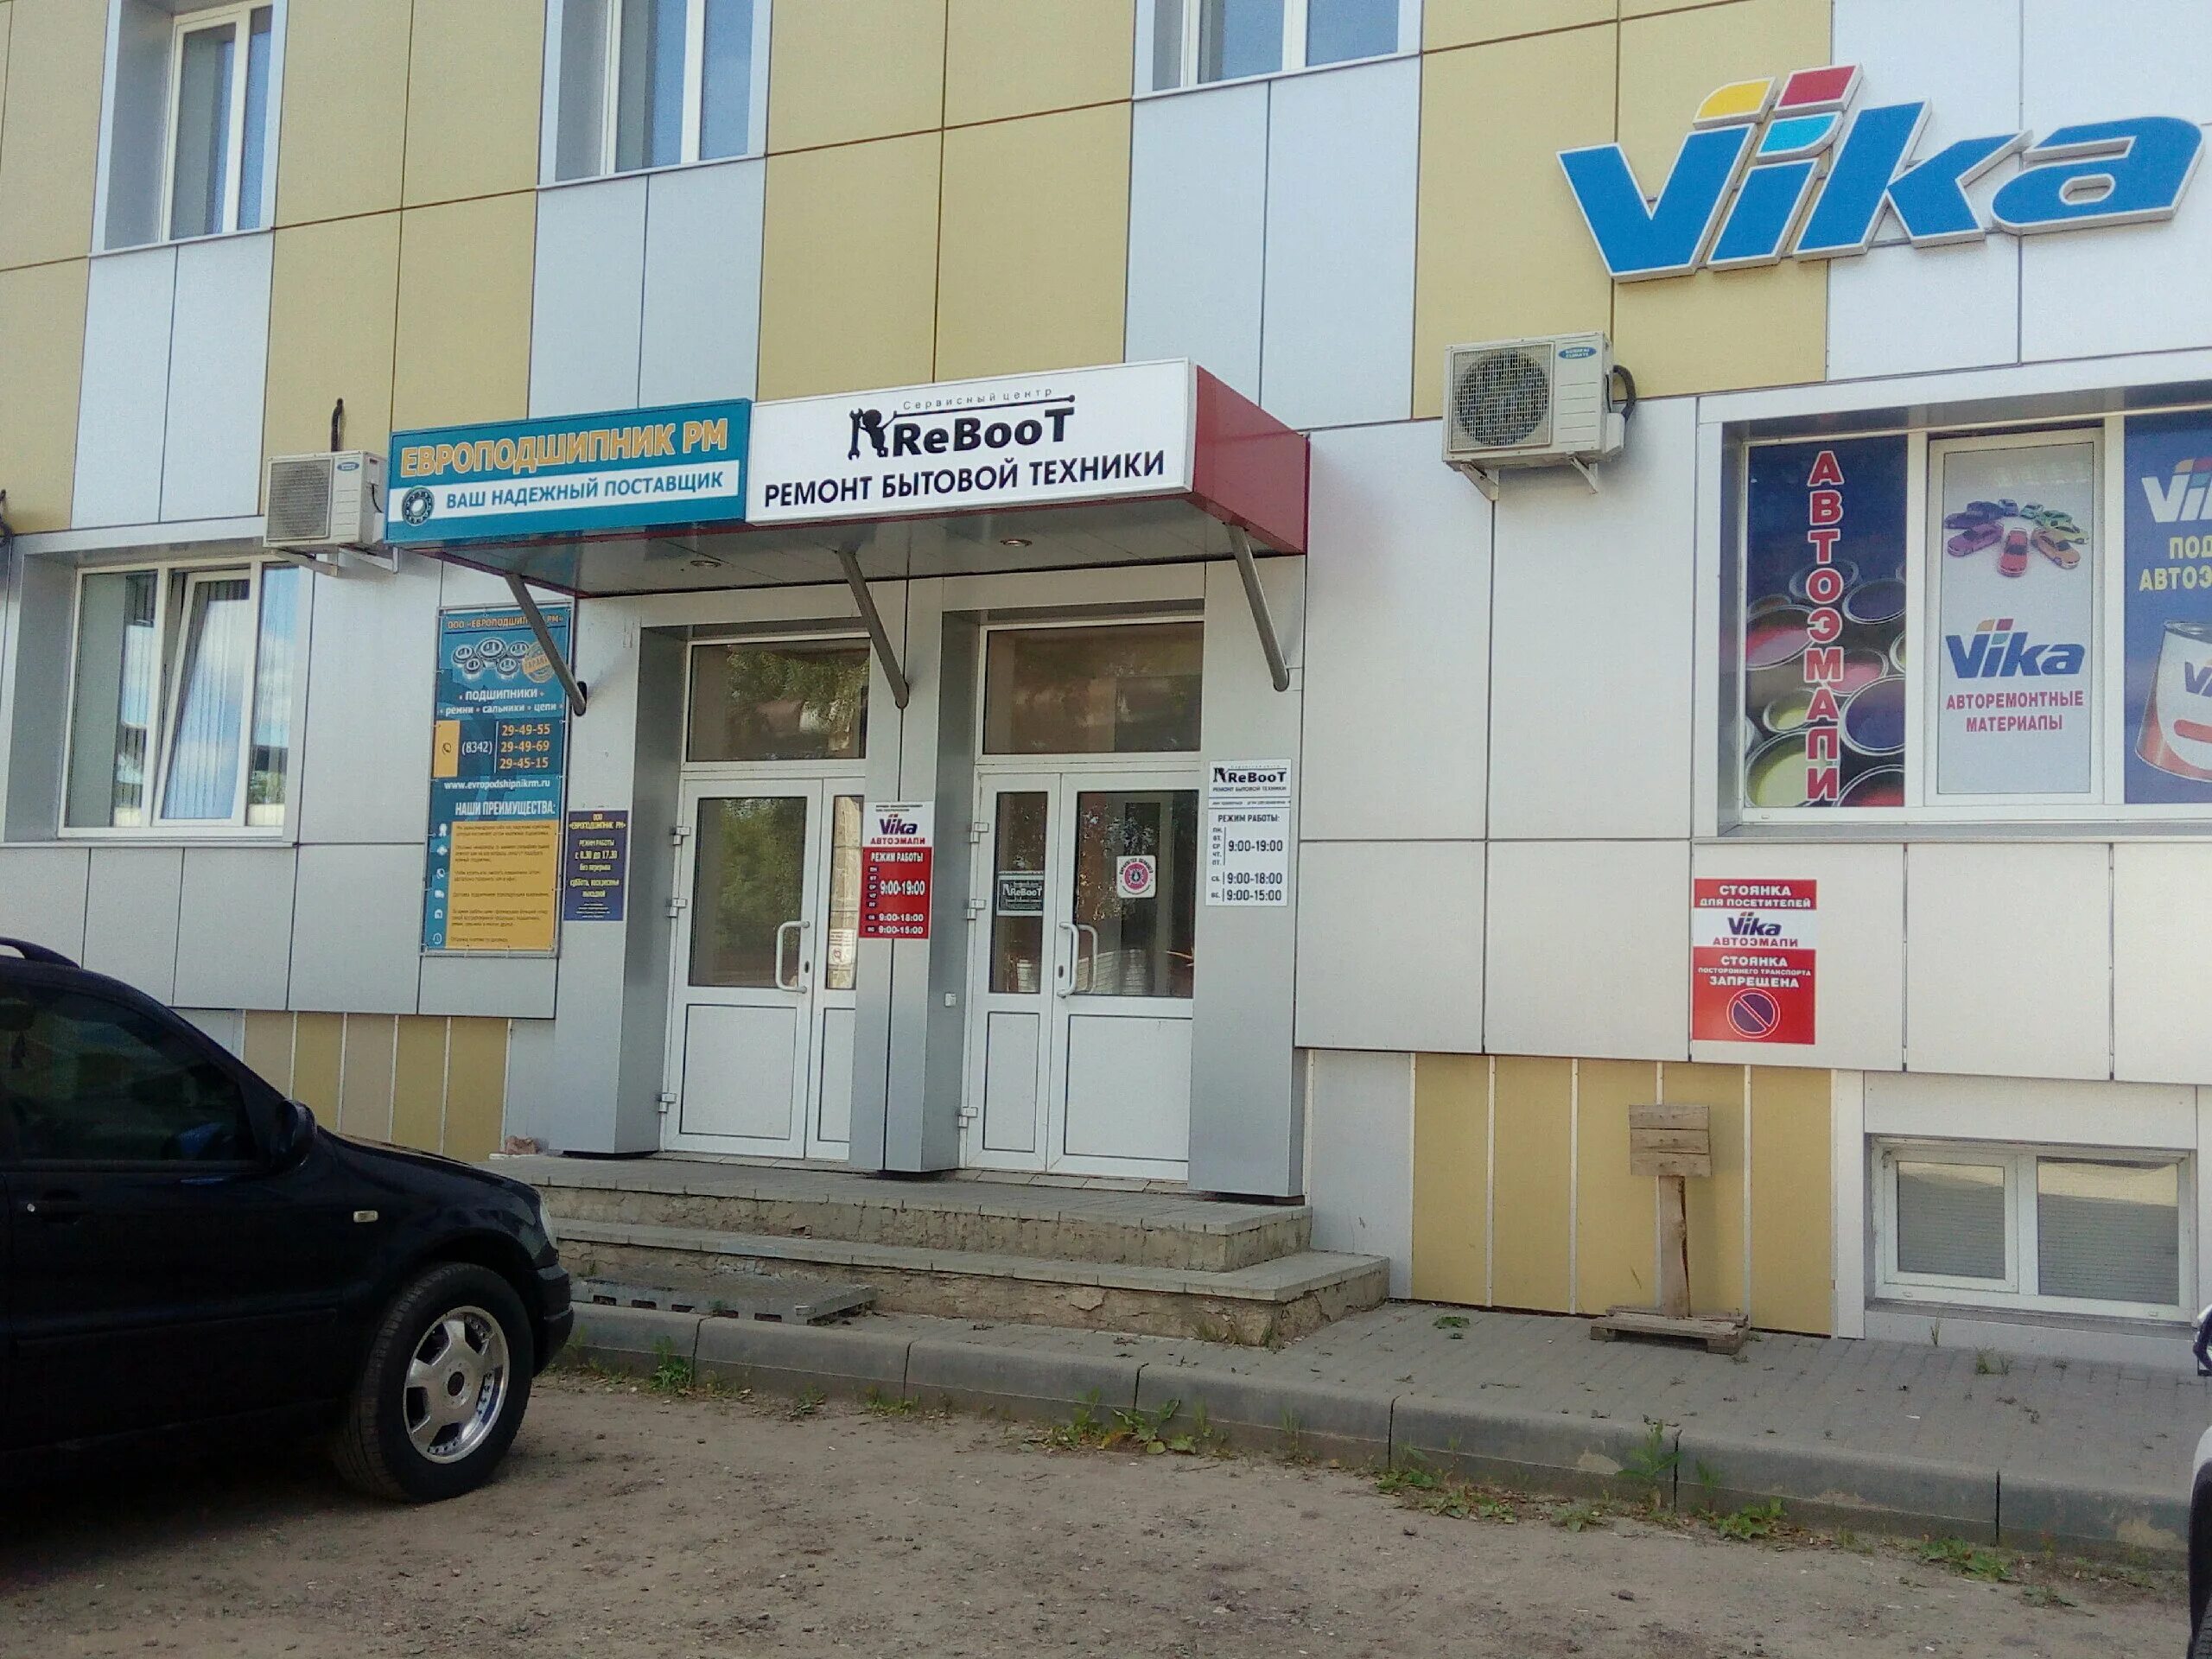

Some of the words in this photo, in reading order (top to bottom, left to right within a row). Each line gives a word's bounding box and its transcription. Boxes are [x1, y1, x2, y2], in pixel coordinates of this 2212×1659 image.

[1556, 63, 2206, 283] Vika
[904, 394, 995, 410] Сервисный
[1003, 388, 1052, 401] центр
[893, 407, 1074, 457] ReBooT
[400, 423, 675, 478] ЕВРОПОДШИПНИК
[683, 418, 728, 454] РМ
[765, 475, 873, 507] РЕМОНТ
[882, 458, 1018, 498] БЫТОВОЙ
[1029, 450, 1165, 486] ТЕХНИКИ
[447, 491, 485, 509] ВАШ
[492, 478, 598, 506] НАДЕЖНЫЙ
[605, 471, 723, 497] ПОСТАВЩИК
[448, 620, 464, 629] ООО
[1803, 450, 1844, 801] АВТОЭМАЛИ
[1945, 619, 2085, 678] Vika
[465, 689, 537, 702] ПОДШИПНИКИ
[1946, 690, 2083, 710] АВТОРЕМОНТНЫЕ
[446, 706, 474, 717] ремни
[482, 704, 524, 714] сальники
[534, 702, 556, 712] цепи
[502, 724, 550, 736] 29-49-55
[1966, 715, 2063, 732] МАТЕРИАЛЫ
[461, 741, 493, 755] (8342)
[501, 741, 550, 753] 29-49-69
[499, 757, 549, 769] 29-45-15
[1228, 771, 1287, 783] ReBooT
[444, 779, 550, 790] www.evropodshipnikrm.ru
[455, 802, 480, 816] НАШИ
[483, 800, 556, 816] ПРЕИМУЩЕСТВА:
[880, 813, 918, 835] Vika
[1228, 839, 1283, 852] 9:00-19:00
[871, 852, 896, 862] РЕЖИМ
[896, 852, 924, 862] РАБОТЫ
[1227, 872, 1282, 884] 9:00-18:00
[880, 880, 925, 896] 9:00-19:00
[1719, 885, 1791, 896] СТОЯНКА
[1226, 889, 1282, 901] 9:00-15:00
[1726, 898, 1811, 908] ПОСЕТИТЕЛЕЙ
[1727, 912, 1782, 936] Vika
[1713, 937, 1798, 948] АВТОЭМАЛИ
[1720, 956, 1788, 967] СТОЯНКА
[1760, 968, 1811, 976] ТРАНСПОРТА
[1709, 976, 1799, 988] ЗАПРЕЩЕНА
